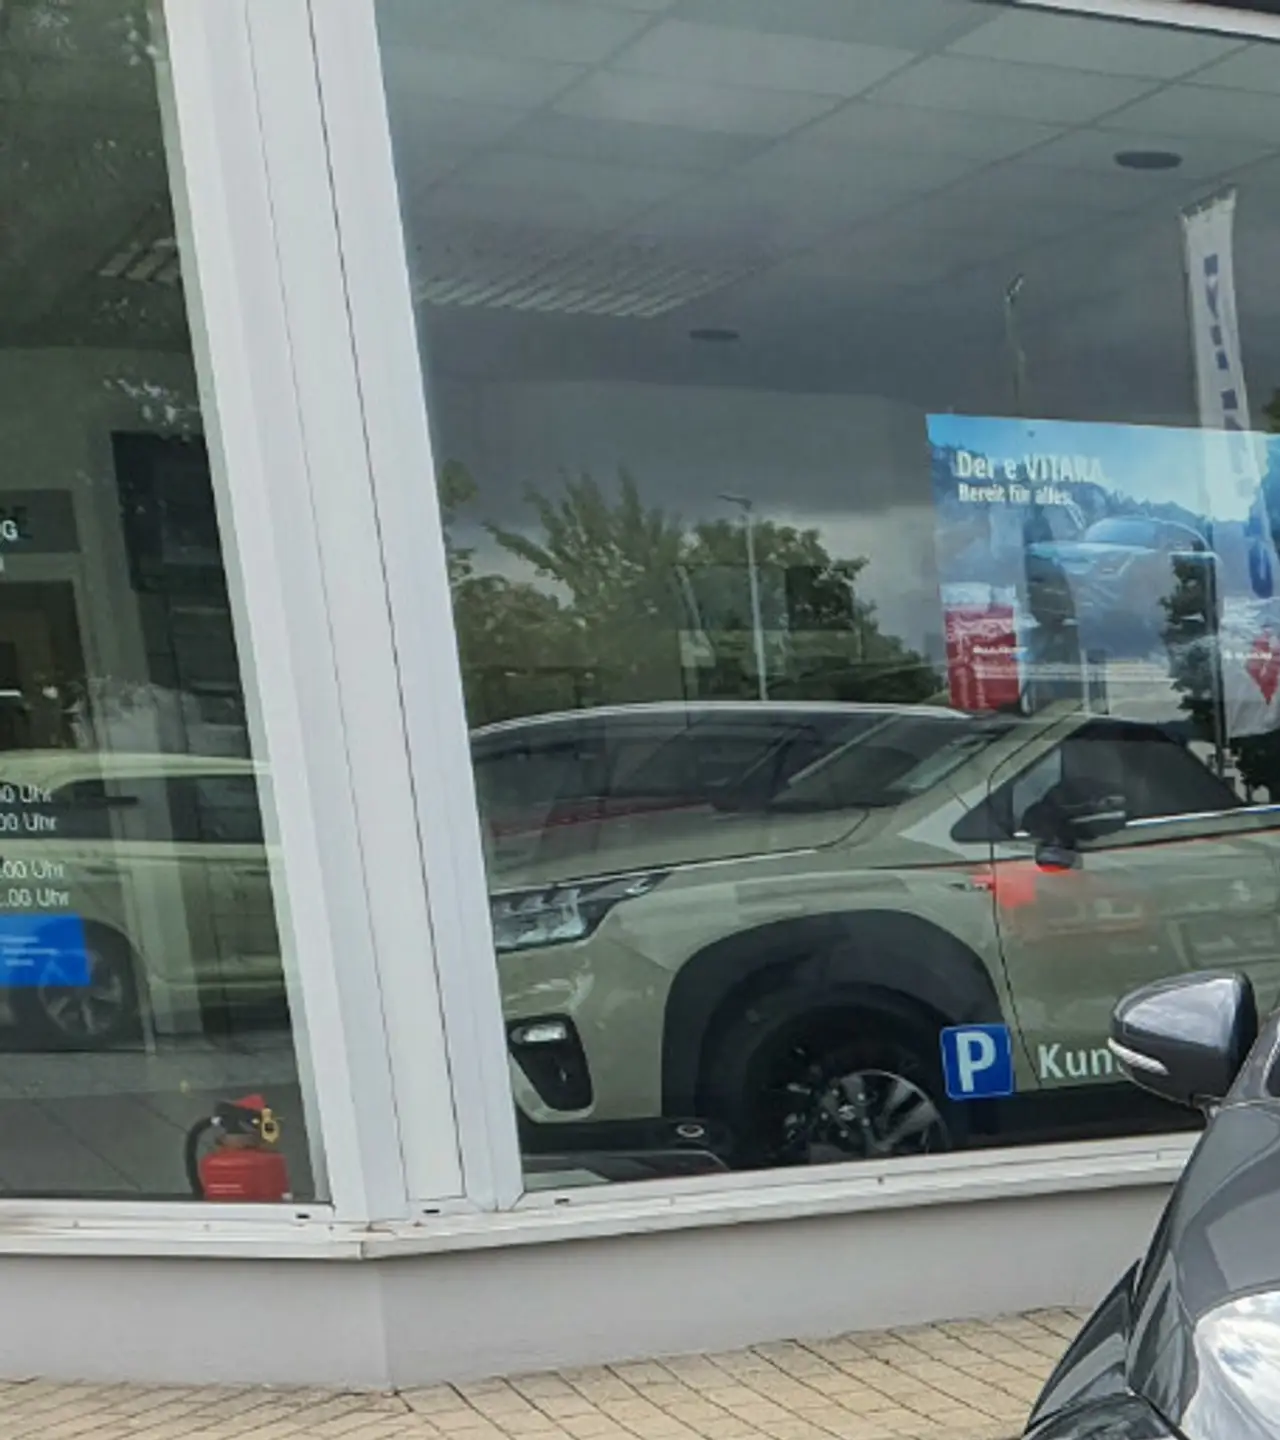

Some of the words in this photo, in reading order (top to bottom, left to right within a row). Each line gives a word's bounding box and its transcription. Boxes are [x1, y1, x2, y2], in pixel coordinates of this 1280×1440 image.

[956, 450, 995, 478] Der
[24, 812, 57, 832] Uhr
[31, 860, 65, 880] Uhr
[37, 888, 70, 907] Uhr
[956, 1032, 996, 1092] P
